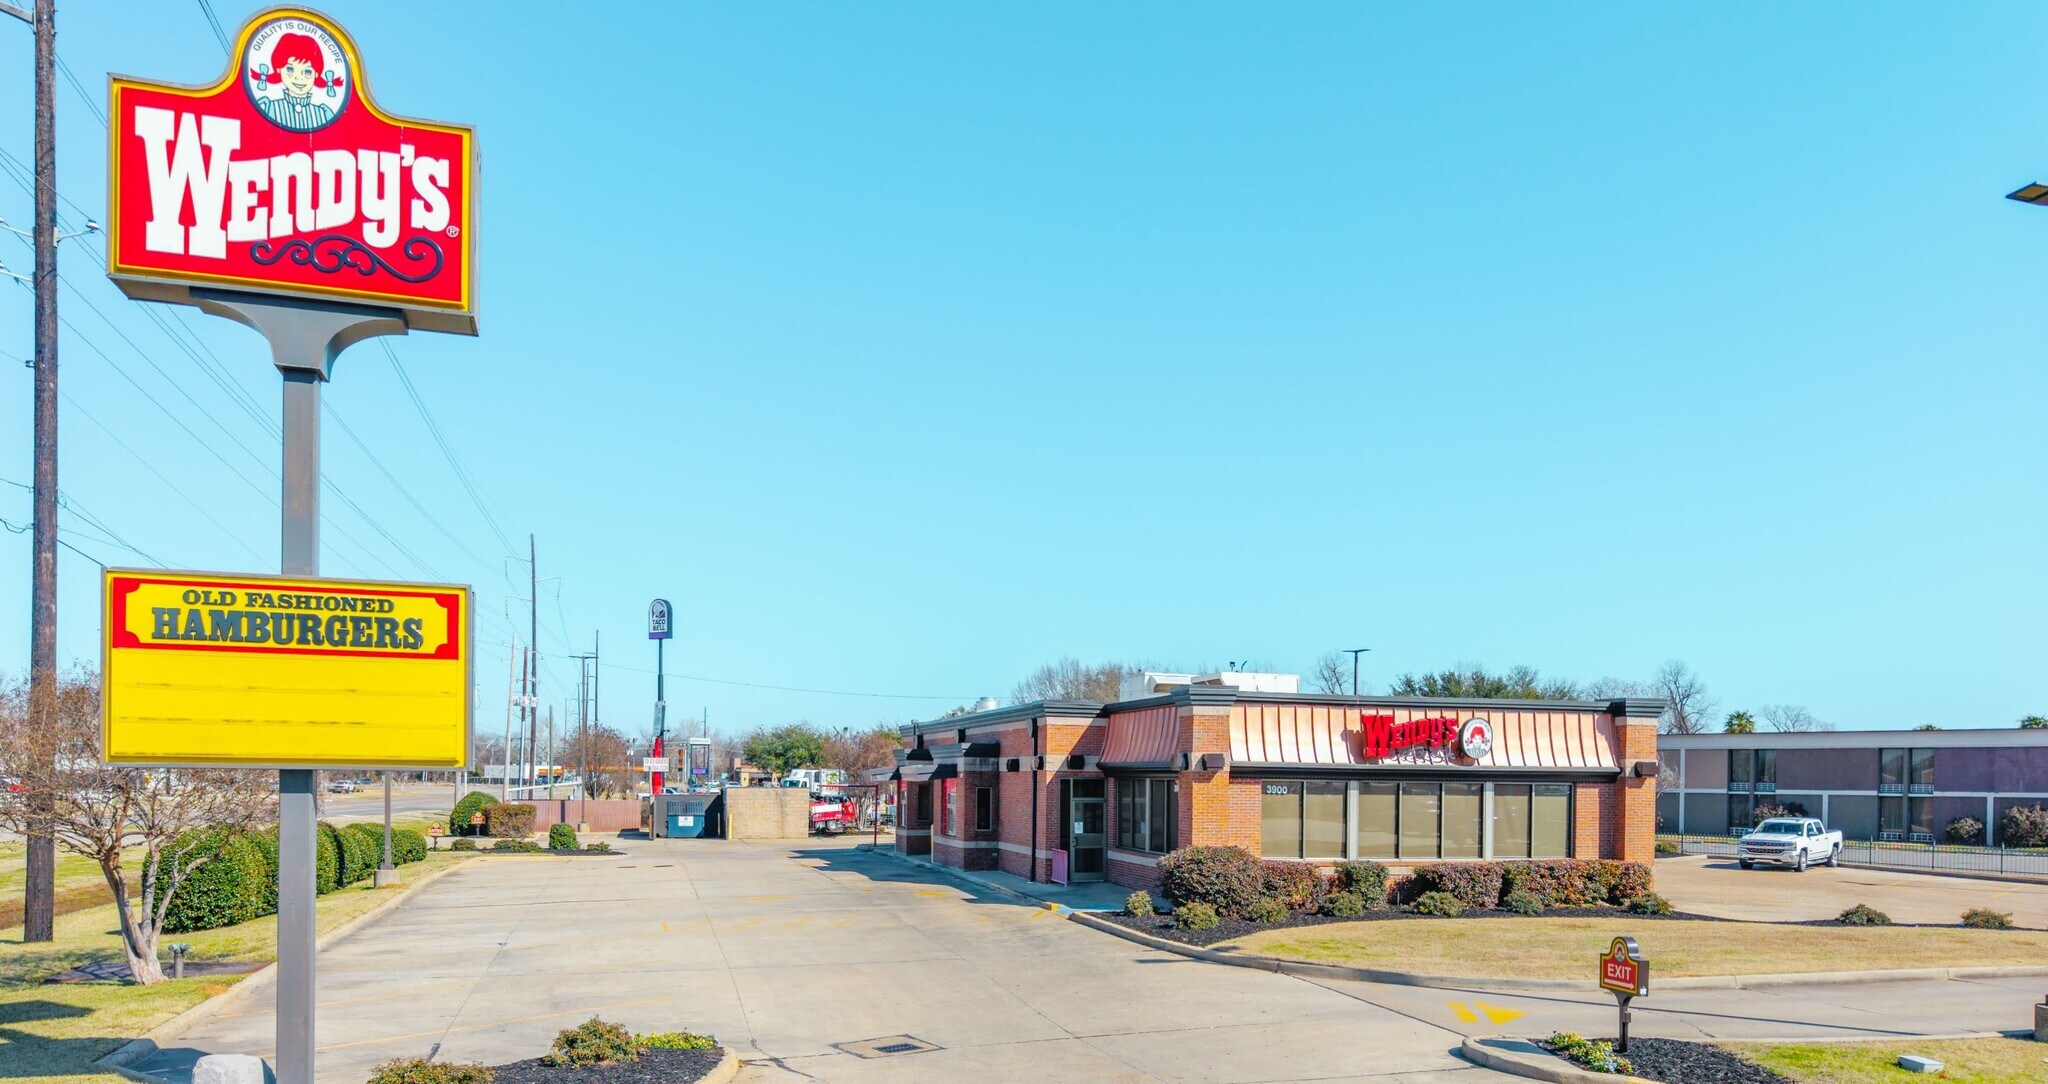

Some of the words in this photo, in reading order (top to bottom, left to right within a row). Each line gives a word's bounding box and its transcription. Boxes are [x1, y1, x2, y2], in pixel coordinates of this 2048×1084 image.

[253, 23, 283, 51] QUALITY
[285, 21, 295, 30] IS
[297, 22, 318, 36] OUR
[319, 33, 343, 64] RECIPE
[182, 590, 237, 606] OLD
[245, 592, 395, 613] FASHIONED
[152, 607, 424, 650] HAMBURGERS
[1266, 785, 1288, 795] 3900
[1607, 963, 1632, 981] EXIT
